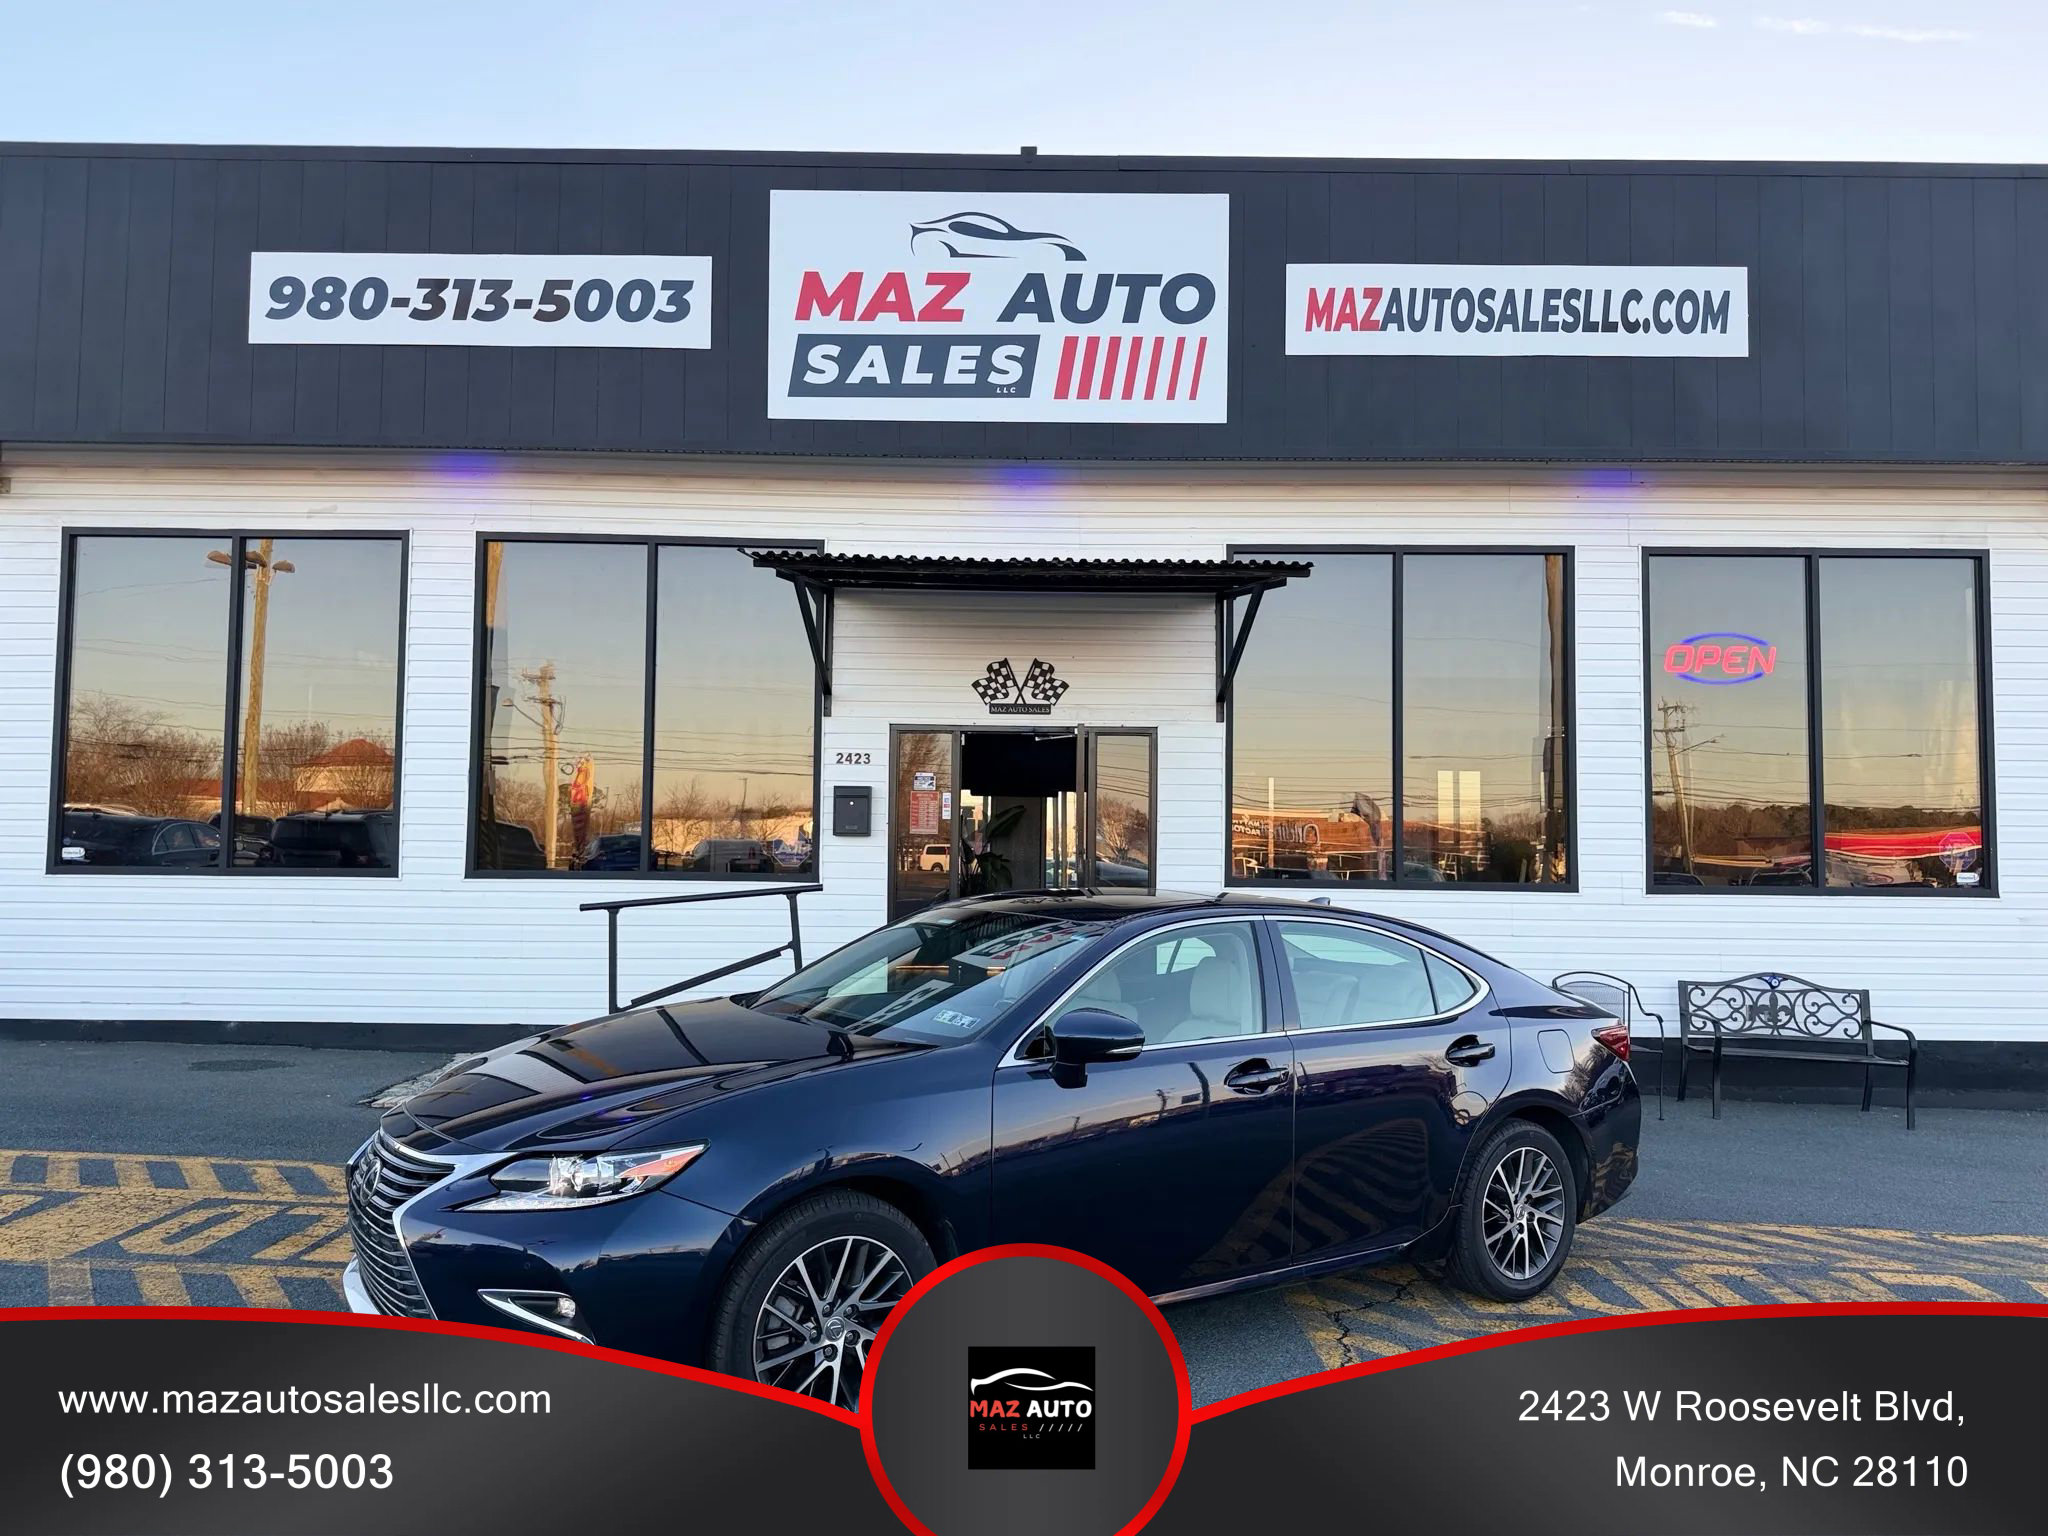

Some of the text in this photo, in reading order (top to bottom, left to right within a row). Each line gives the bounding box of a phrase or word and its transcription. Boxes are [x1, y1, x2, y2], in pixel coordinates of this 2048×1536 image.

[264, 276, 694, 323] 980-313-5003
[795, 271, 1216, 325] MAZ AUTO
[1305, 287, 1730, 334] MAZAUTOSALESLLC.COM
[803, 344, 1025, 385] SALES
[996, 386, 1016, 394] LLC
[1664, 644, 1776, 674] OPEN
[836, 753, 871, 764] 2423
